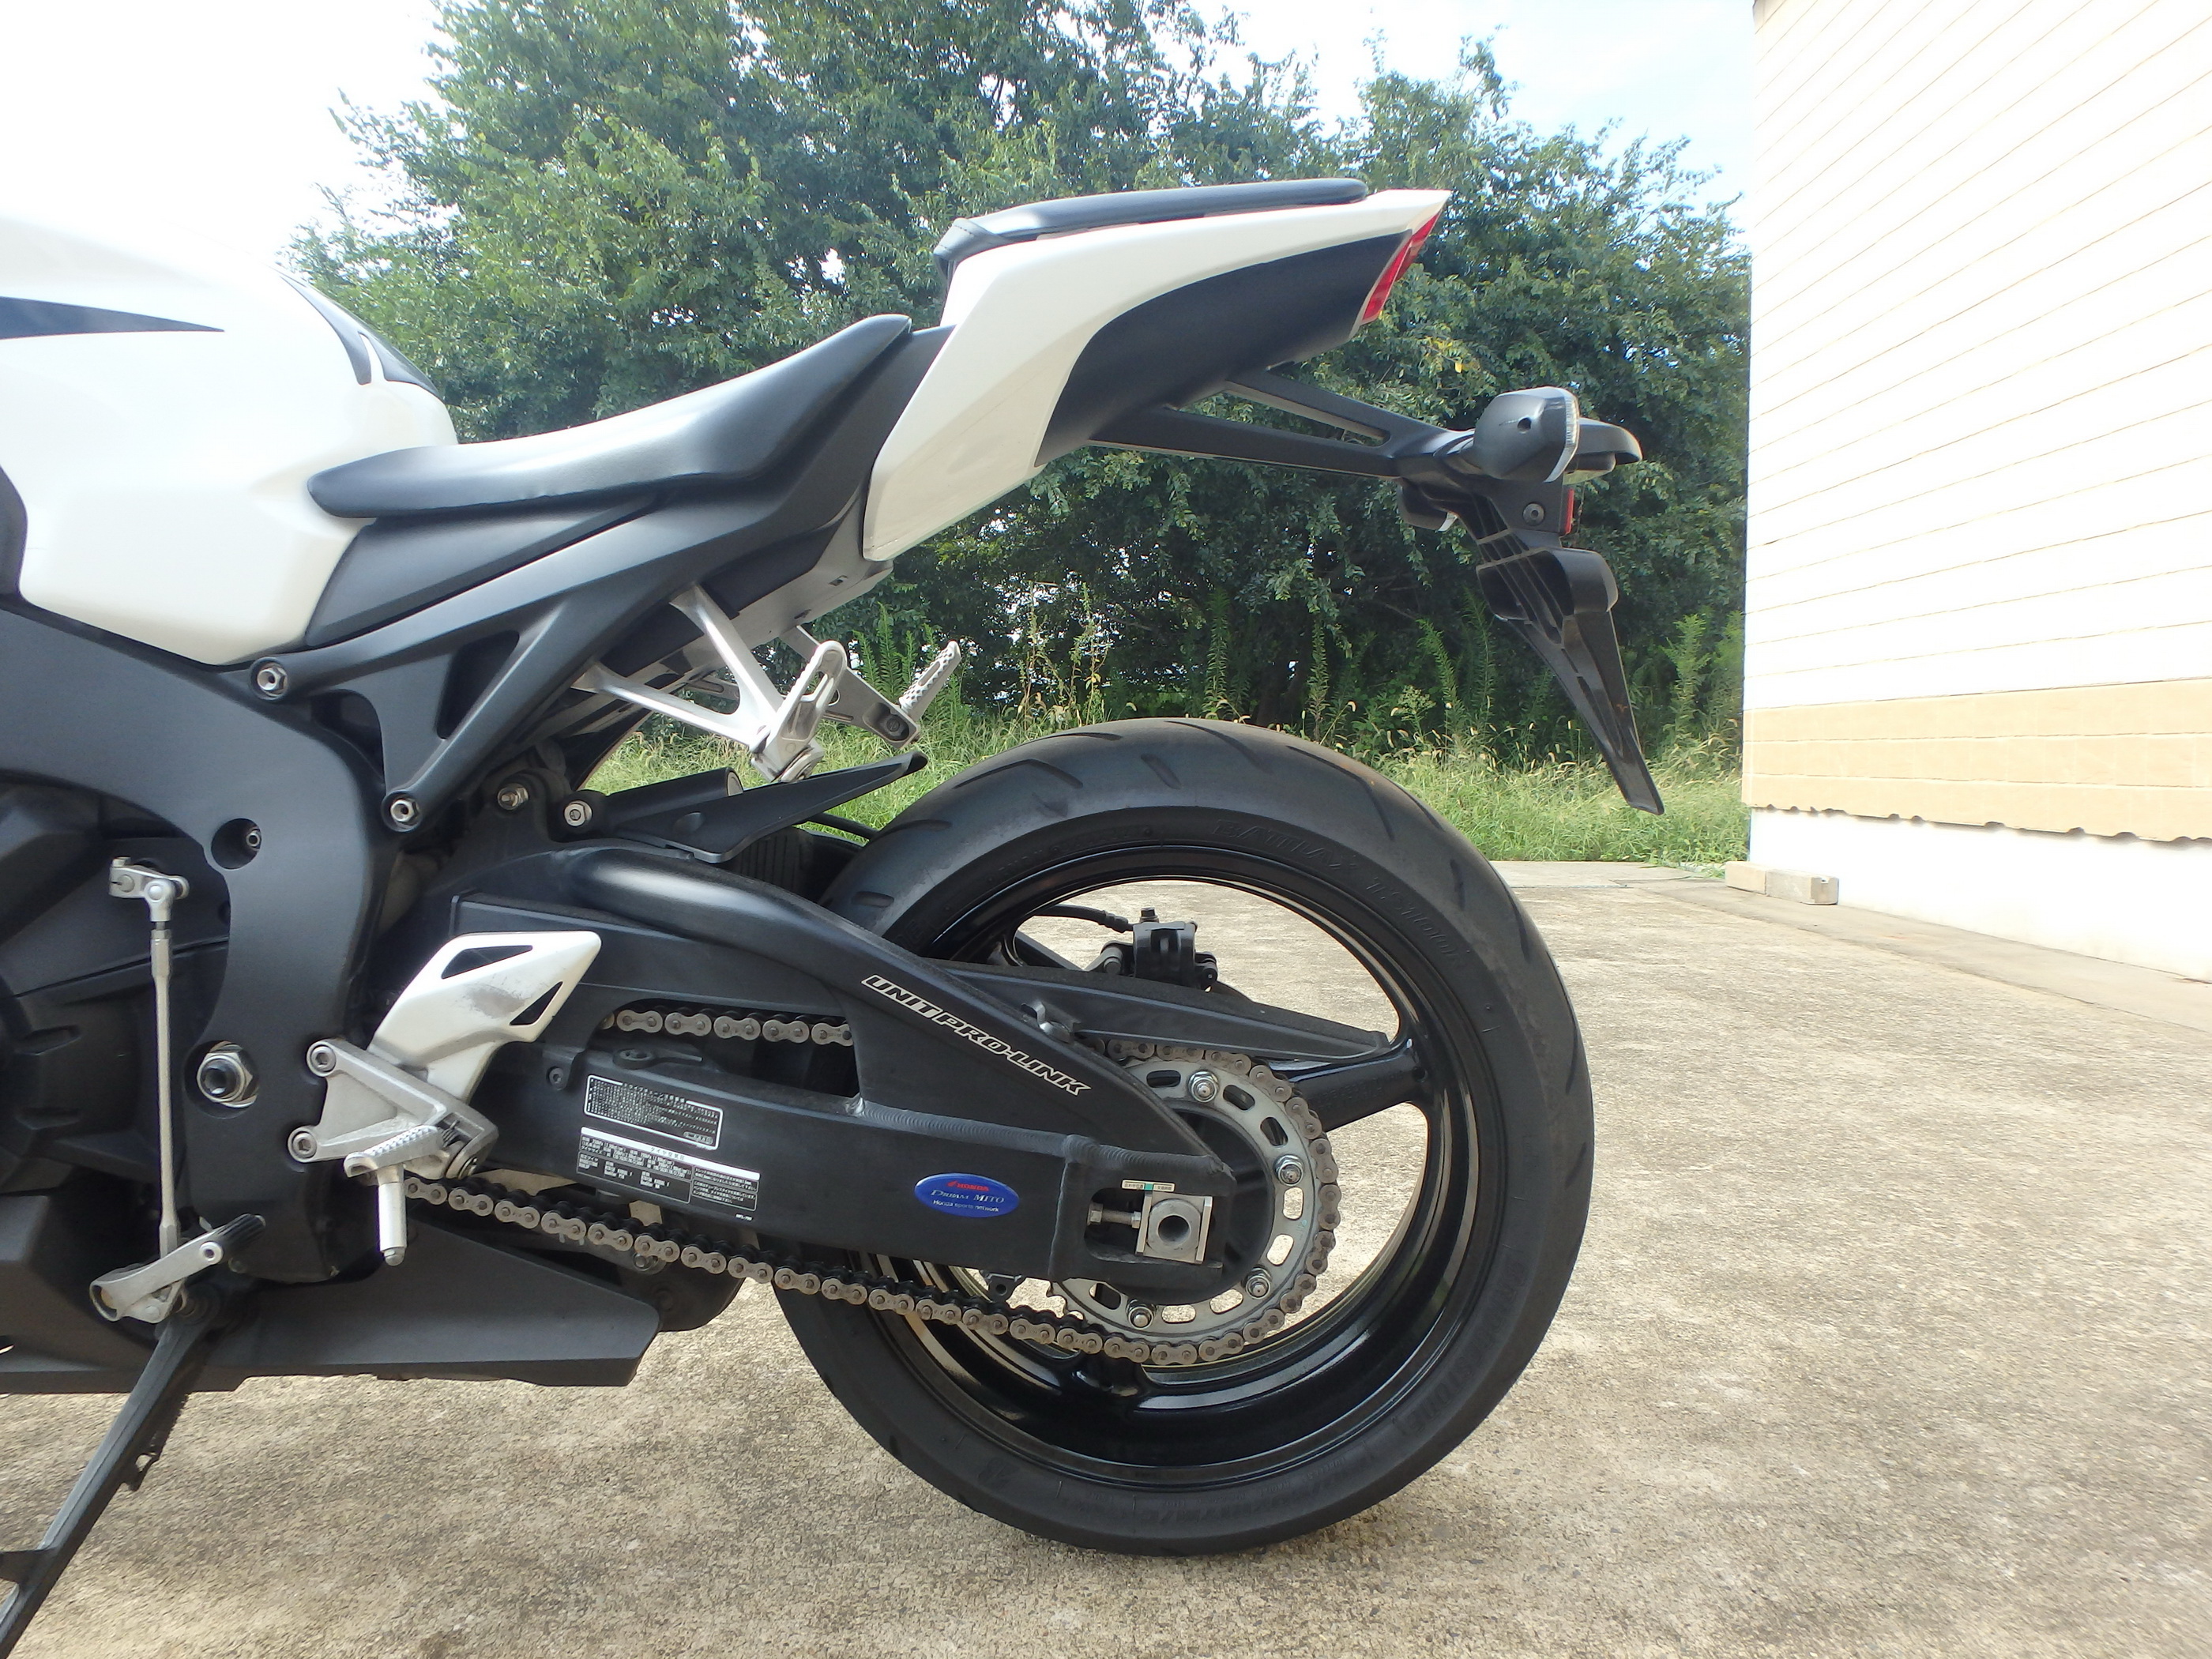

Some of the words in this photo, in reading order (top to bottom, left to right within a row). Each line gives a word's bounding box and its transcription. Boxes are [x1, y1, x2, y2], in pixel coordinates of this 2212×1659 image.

[862, 975, 942, 1018] UNIT
[932, 1012, 1091, 1095] PRO-LINK
[933, 1198, 954, 1207] Honda
[975, 1204, 999, 1213] network
